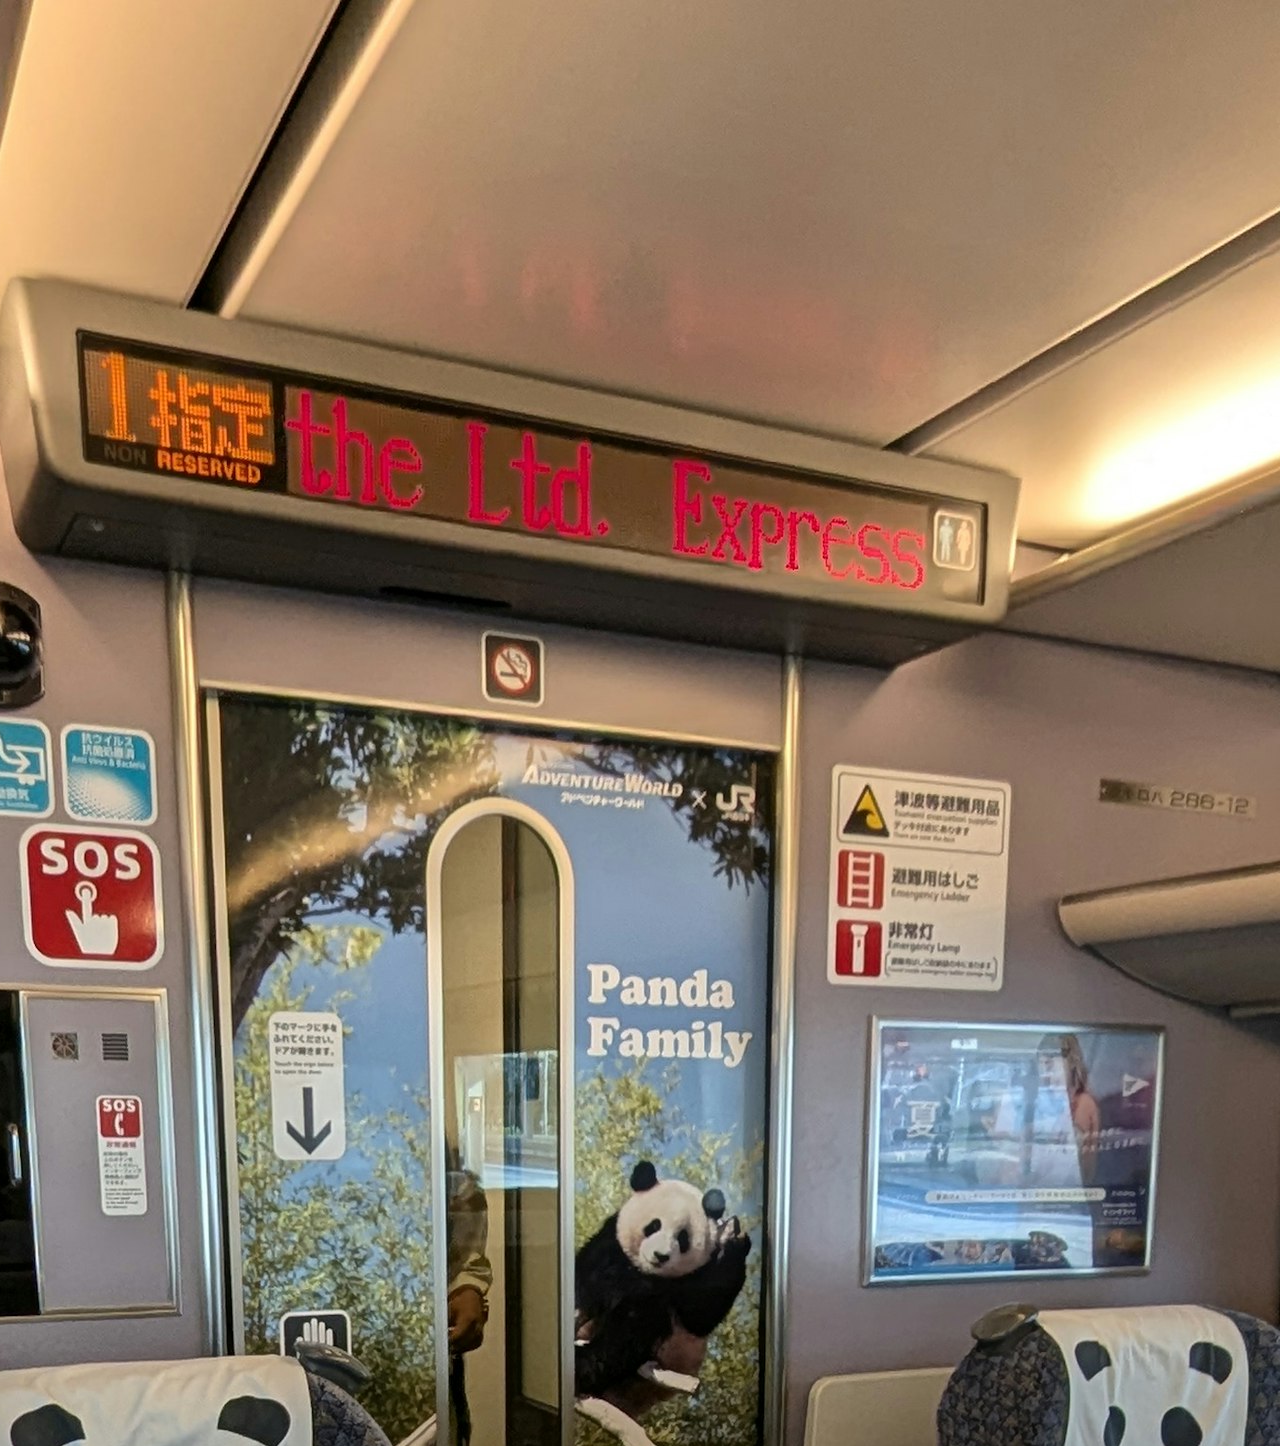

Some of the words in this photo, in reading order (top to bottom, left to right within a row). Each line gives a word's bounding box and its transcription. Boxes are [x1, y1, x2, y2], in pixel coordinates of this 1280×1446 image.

[102, 351, 137, 442] 1
[149, 369, 275, 466] 指定
[157, 450, 262, 484] RESERVED
[286, 390, 424, 512] the
[467, 418, 612, 537] Ltd.
[671, 459, 926, 591] Express
[716, 784, 756, 813] JR
[894, 789, 1000, 817] 津波等避難用品
[1170, 791, 1249, 814] 286-12
[39, 838, 142, 881] SOS
[891, 867, 980, 890] 避難用はしご
[891, 888, 939, 902] Emergency
[940, 891, 971, 903] Ladder
[888, 921, 935, 941] 非常灯
[888, 940, 935, 955] Emergency
[937, 943, 961, 955] Lamp
[586, 962, 735, 1009] Panda
[273, 1034, 335, 1045] ふれてください。
[586, 1016, 754, 1069] Family
[102, 1099, 136, 1113] SOS
